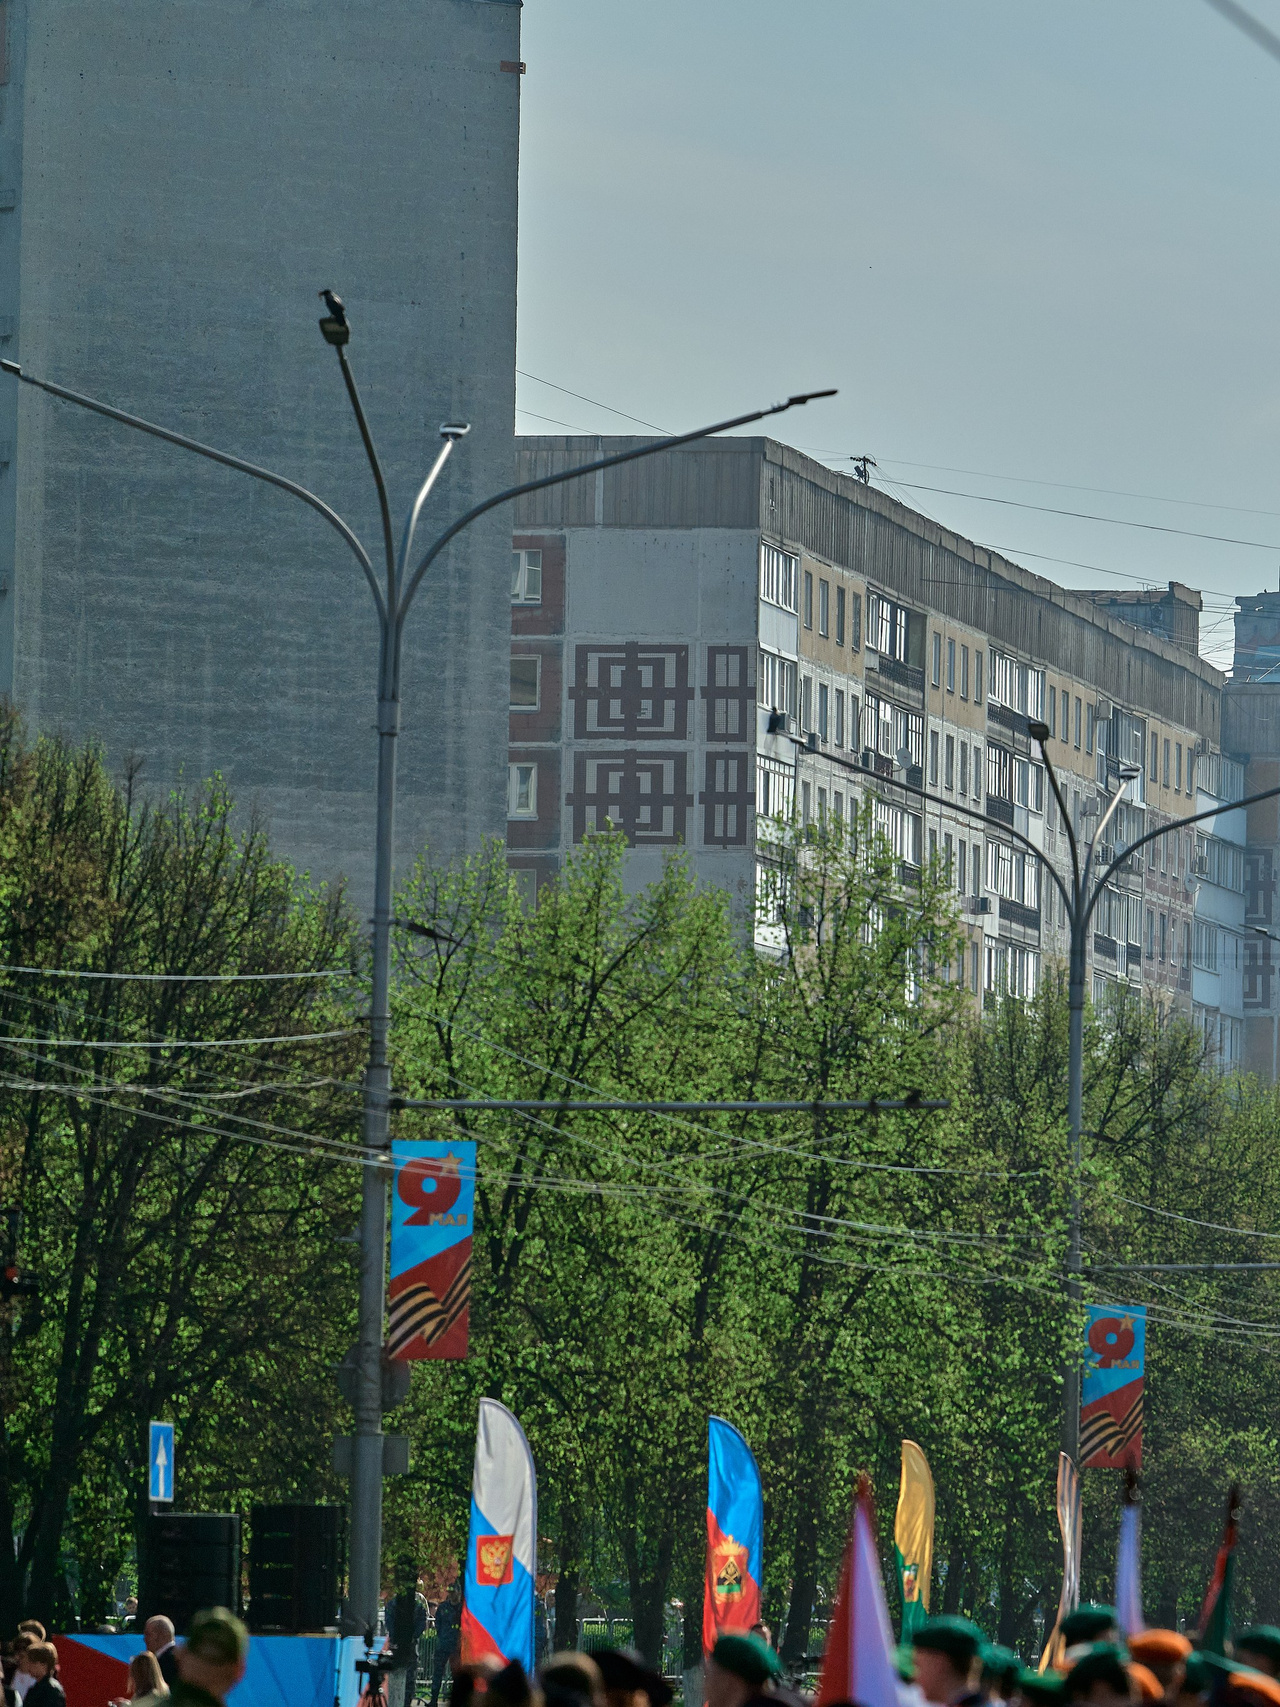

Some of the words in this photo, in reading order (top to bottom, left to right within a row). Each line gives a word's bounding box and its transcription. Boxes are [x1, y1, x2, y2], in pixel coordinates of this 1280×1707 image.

[397, 1156, 462, 1227] 9
[429, 1212, 469, 1227] МАЯ
[1088, 1317, 1135, 1369] 9
[1110, 1359, 1140, 1370] МАЯ
